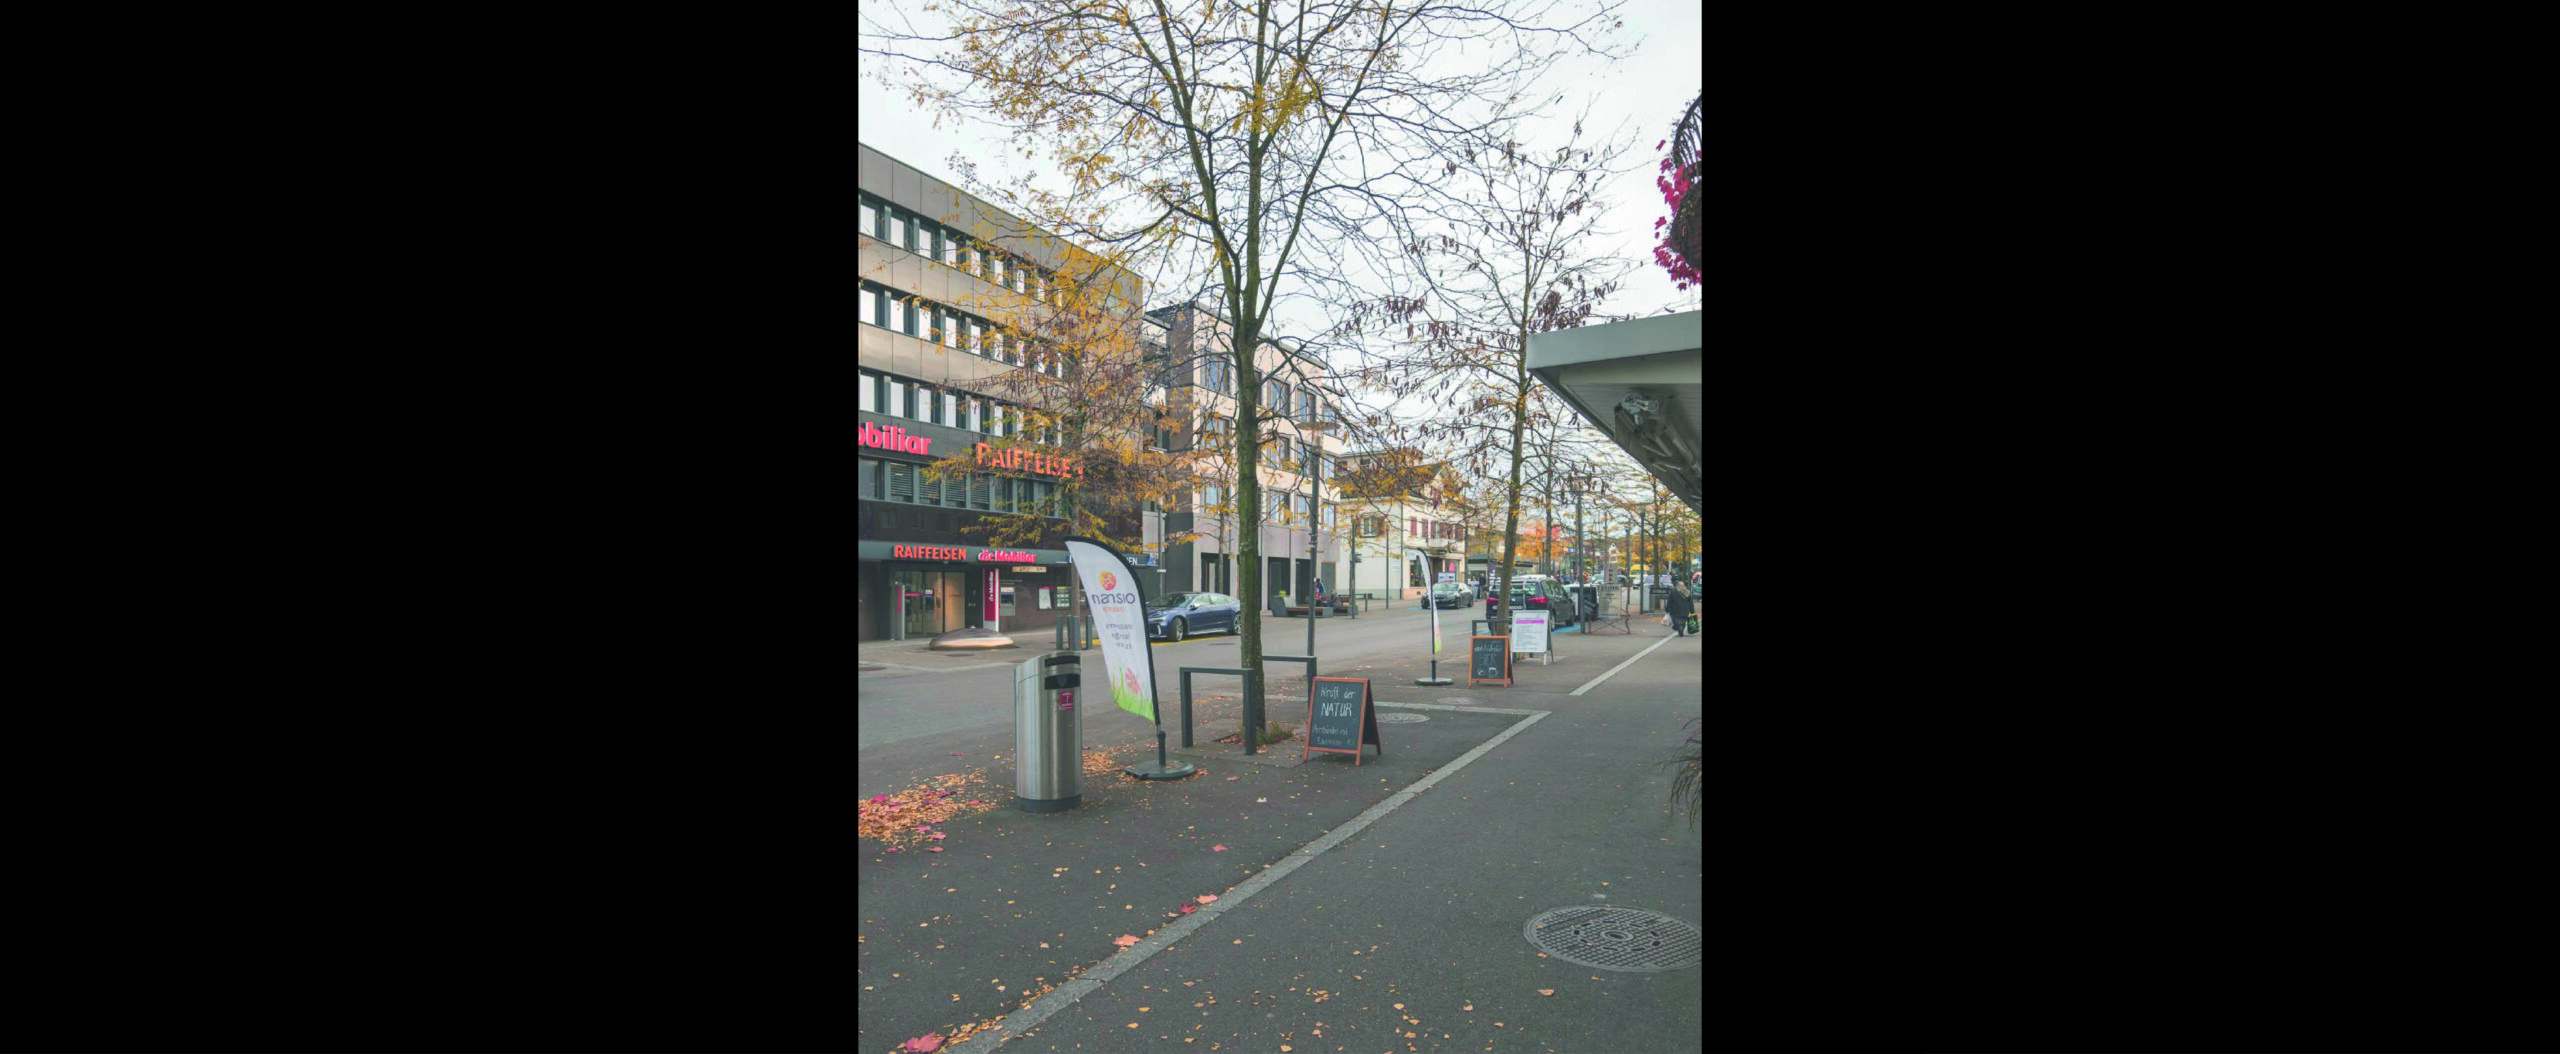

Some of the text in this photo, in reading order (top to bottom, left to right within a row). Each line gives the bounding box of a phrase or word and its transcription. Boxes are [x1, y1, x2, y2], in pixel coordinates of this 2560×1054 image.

[895, 545, 966, 560] RAIFFEISEN
[978, 549, 1036, 563] die Mobiliar
[1321, 702, 1352, 717] NATUR
